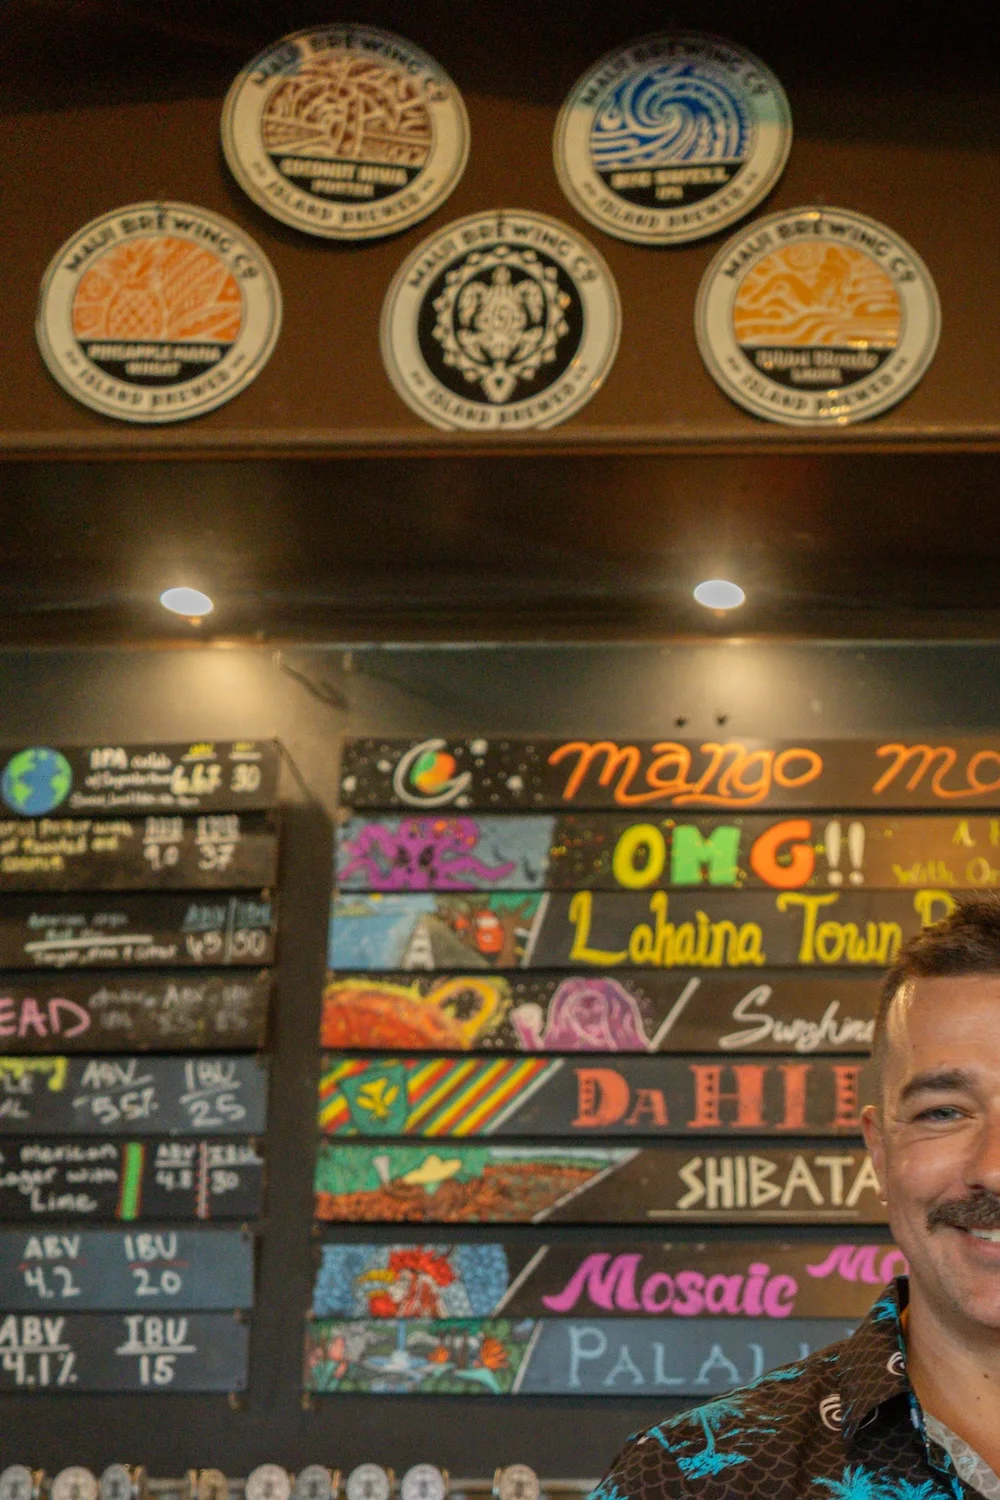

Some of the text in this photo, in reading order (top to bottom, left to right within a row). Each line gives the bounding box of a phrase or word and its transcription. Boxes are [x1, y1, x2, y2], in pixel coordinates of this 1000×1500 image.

[952, 820, 976, 849] A
[612, 820, 865, 889] OMG!!
[569, 890, 765, 966] Lahaina
[776, 892, 902, 966] Town
[81, 1060, 137, 1088] ABV
[185, 1060, 236, 1091] IBU
[188, 1094, 246, 1127] 25
[31, 1187, 98, 1212] Lime
[23, 1232, 177, 1261] ABV IBU
[24, 1265, 182, 1298] 4.2 20
[543, 1253, 798, 1318] Mosaic
[0, 1314, 188, 1347] ABV IBU
[139, 1354, 177, 1386] 15
